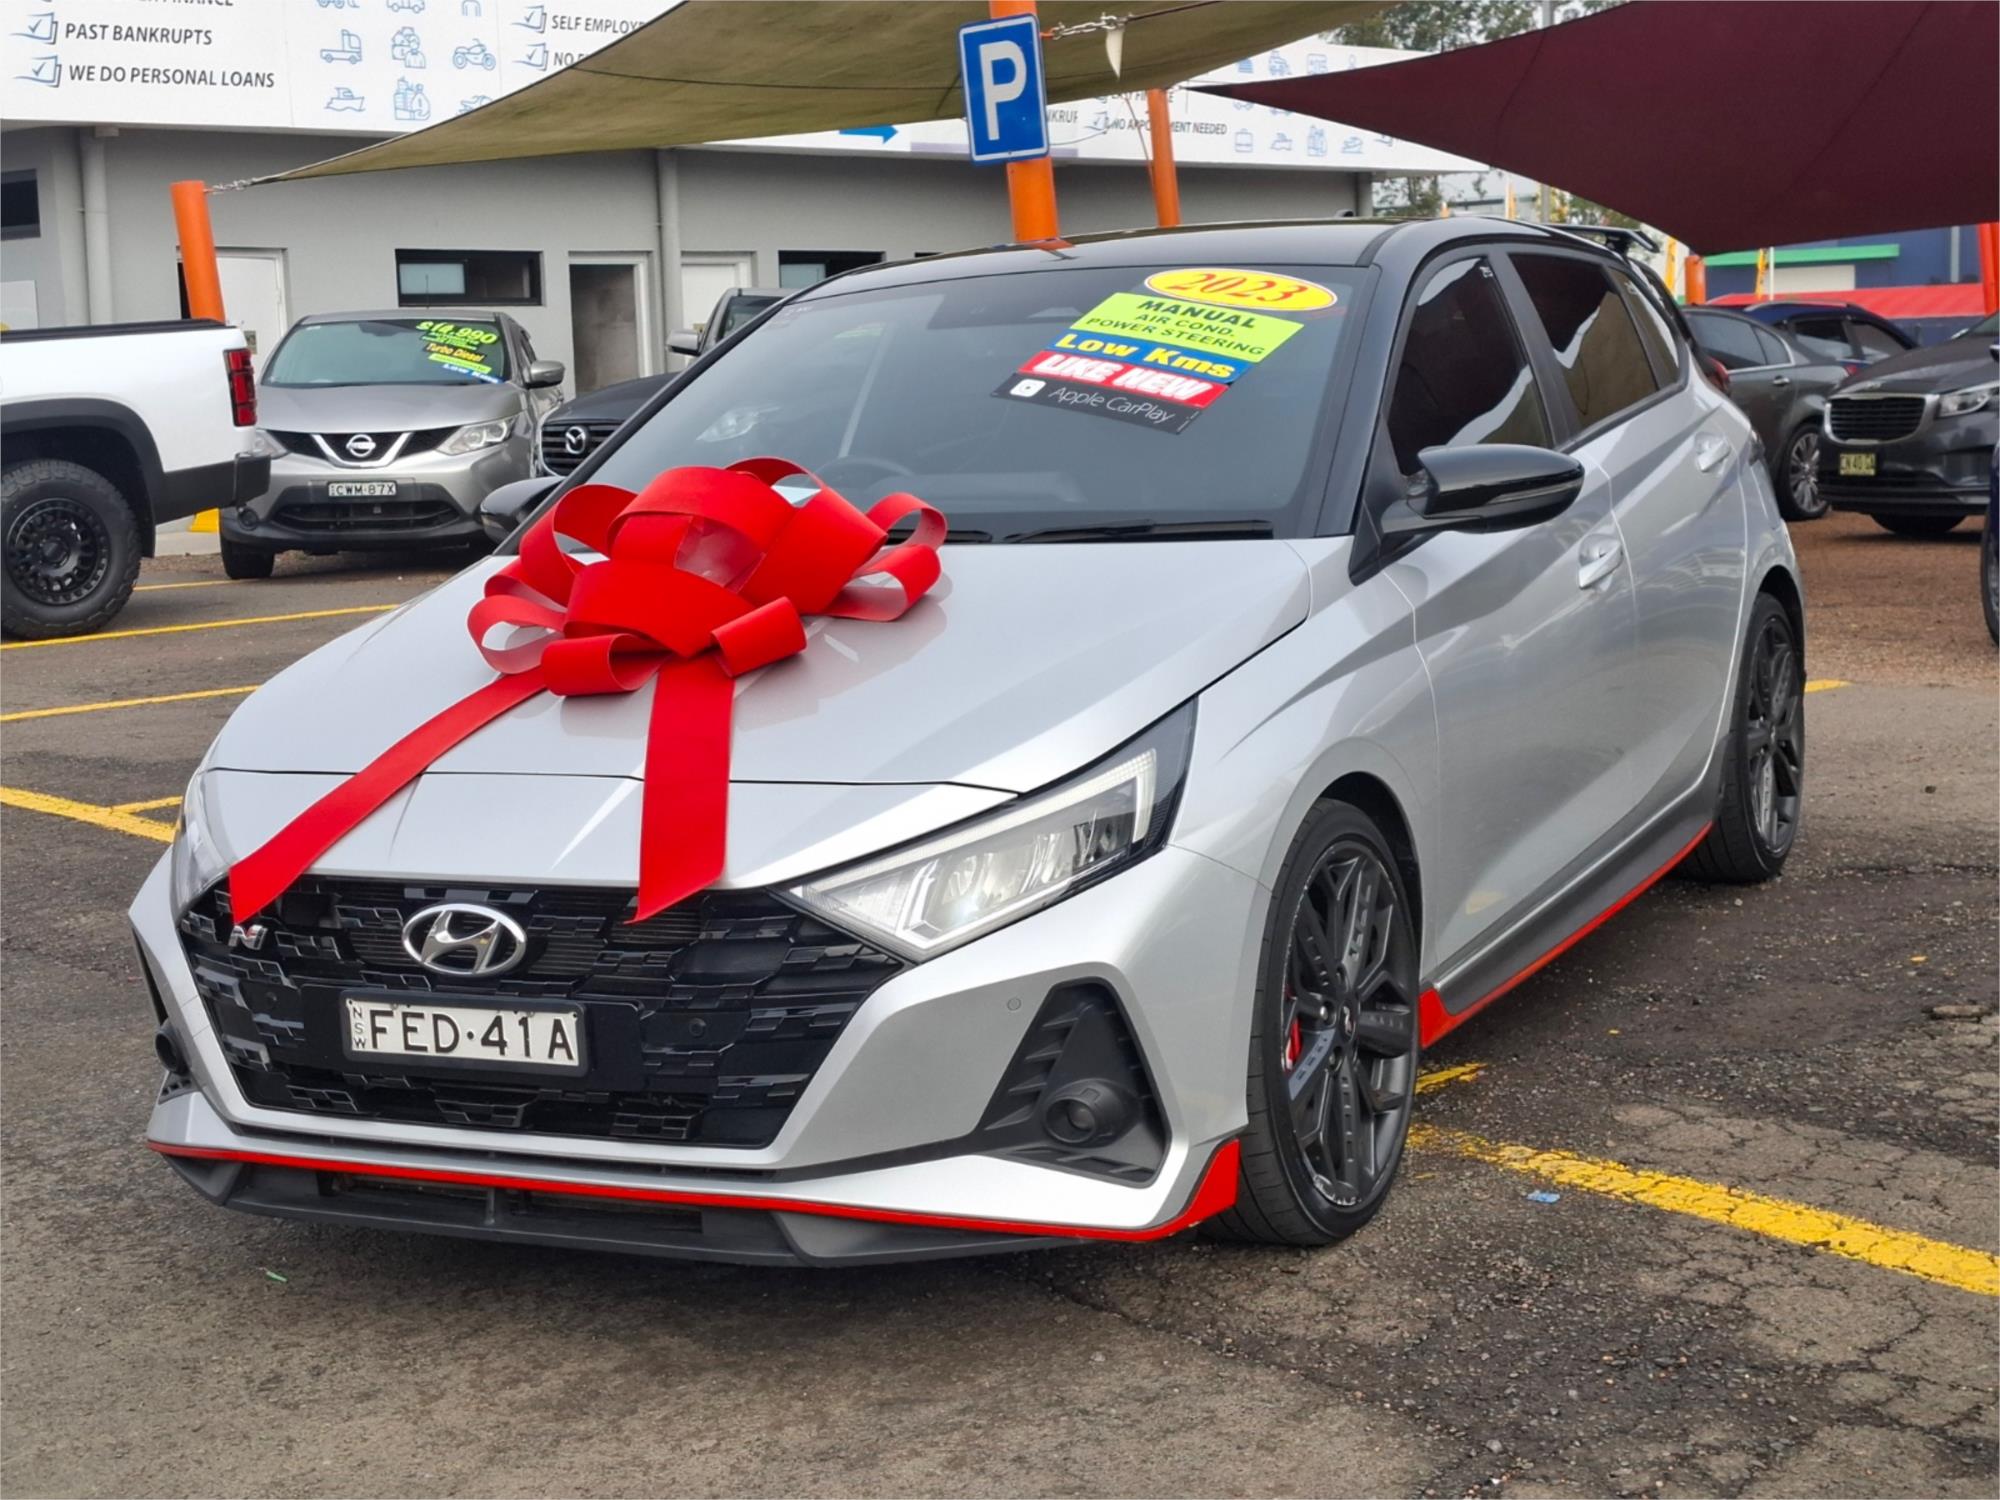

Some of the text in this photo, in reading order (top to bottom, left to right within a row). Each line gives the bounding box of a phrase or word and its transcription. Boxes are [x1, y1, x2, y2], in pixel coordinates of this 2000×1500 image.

[65, 23, 213, 45] PAST BANKRUPTS
[552, 15, 582, 30] SELF
[553, 52, 574, 66] NO
[69, 65, 275, 88] WE DO PERSONAL LOANS
[979, 40, 1027, 141] P
[1192, 121, 1228, 135] NEEDED
[1167, 273, 1308, 302] 2023
[1135, 313, 1236, 337] AIR COND.
[1137, 300, 1256, 329] MANUAL
[1085, 317, 1267, 356] POWER STEERING
[1033, 354, 1213, 401] LIKE NEW
[1143, 347, 1236, 379] Kms
[1048, 386, 1106, 408] Apple
[1106, 396, 1175, 425] CarPlay
